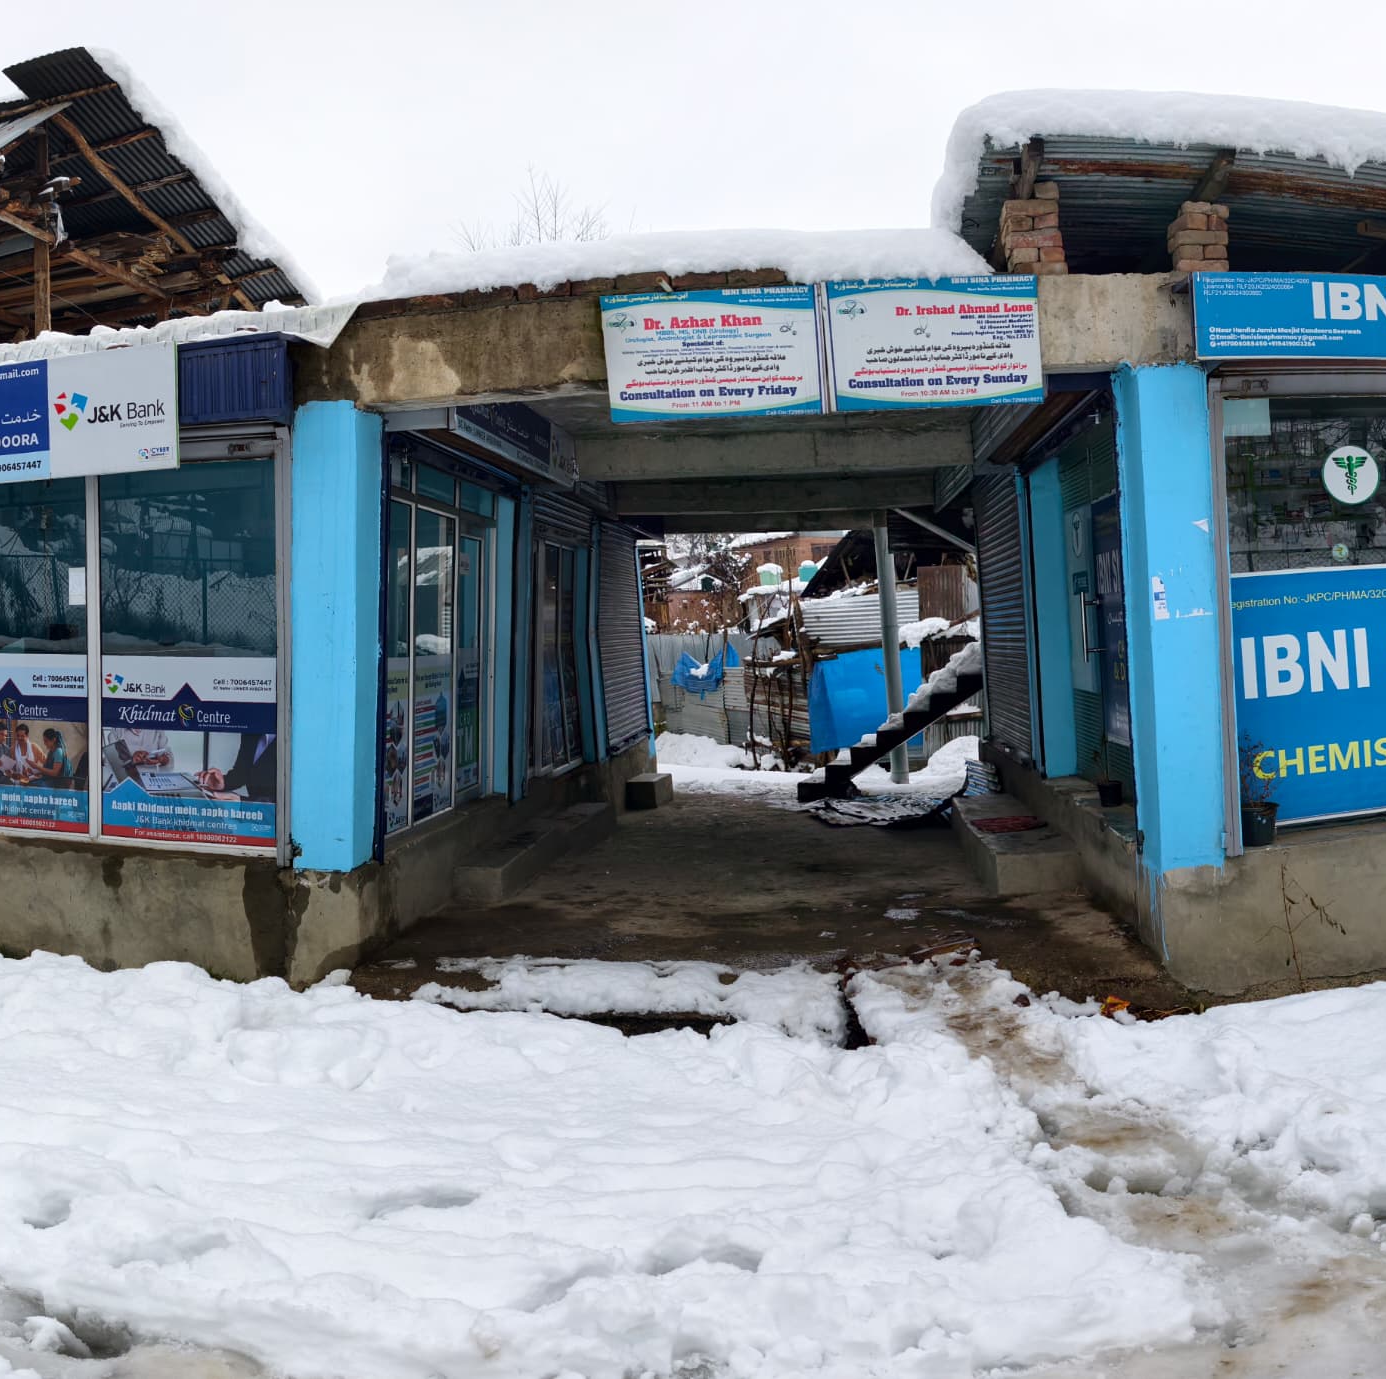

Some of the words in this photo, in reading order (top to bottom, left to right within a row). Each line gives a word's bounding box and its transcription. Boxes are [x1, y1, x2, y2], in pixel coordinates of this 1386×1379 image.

[763, 286, 809, 294] PHARMACY
[895, 305, 912, 316] Dr.
[916, 303, 955, 316] Irshad
[958, 302, 1000, 314] Ahmad
[1003, 302, 1034, 313] Lone
[643, 317, 665, 331] Dr.
[669, 315, 716, 329] Azhar
[720, 313, 763, 328] Khan
[848, 376, 924, 389] Consultation
[927, 377, 943, 386] on
[945, 375, 980, 387] Every
[982, 372, 1028, 385] Sunday
[619, 388, 696, 401] Consultation
[699, 388, 715, 397] on
[718, 386, 755, 398] Every
[757, 384, 798, 397] Friday
[0, 408, 42, 425] خدمت
[87, 403, 123, 424] J&K
[126, 398, 166, 420] Bank
[1230, 598, 1281, 610] egistration
[1240, 626, 1371, 700] IBNI
[123, 682, 143, 693] J&K
[144, 682, 166, 693] Bank
[213, 678, 226, 686] Cell
[18, 703, 48, 717] Centre
[118, 704, 176, 724] Khidmat
[196, 710, 231, 724] Centre
[137, 802, 174, 814] Khidmat
[230, 807, 264, 821] kareeb
[134, 828, 147, 837] For
